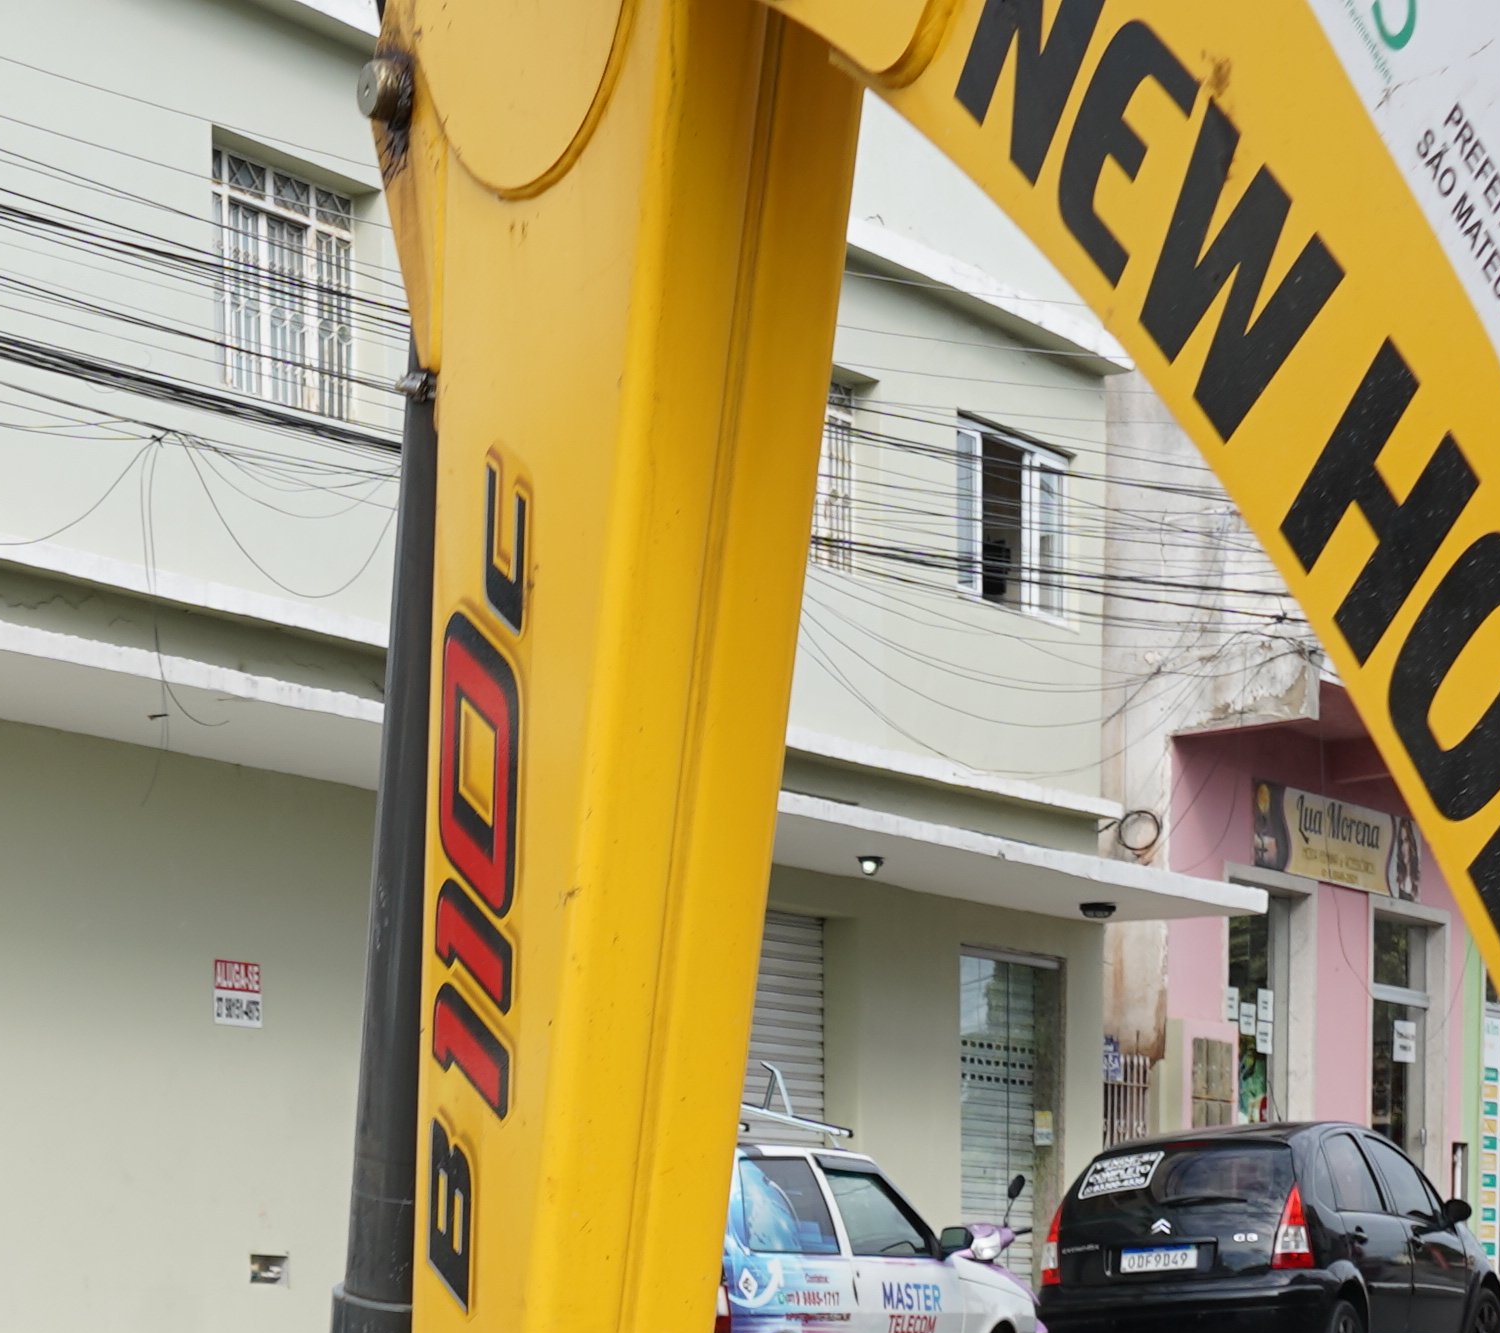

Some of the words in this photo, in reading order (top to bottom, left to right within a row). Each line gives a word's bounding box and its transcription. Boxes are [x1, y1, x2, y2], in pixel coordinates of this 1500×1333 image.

[1415, 129, 1457, 198] SÃO
[954, 0, 1346, 444] NEW
[1296, 794, 1323, 845] Lua
[1326, 801, 1381, 850] Morena
[216, 961, 260, 992] ALUGA-SE
[881, 1281, 943, 1312] MASTER
